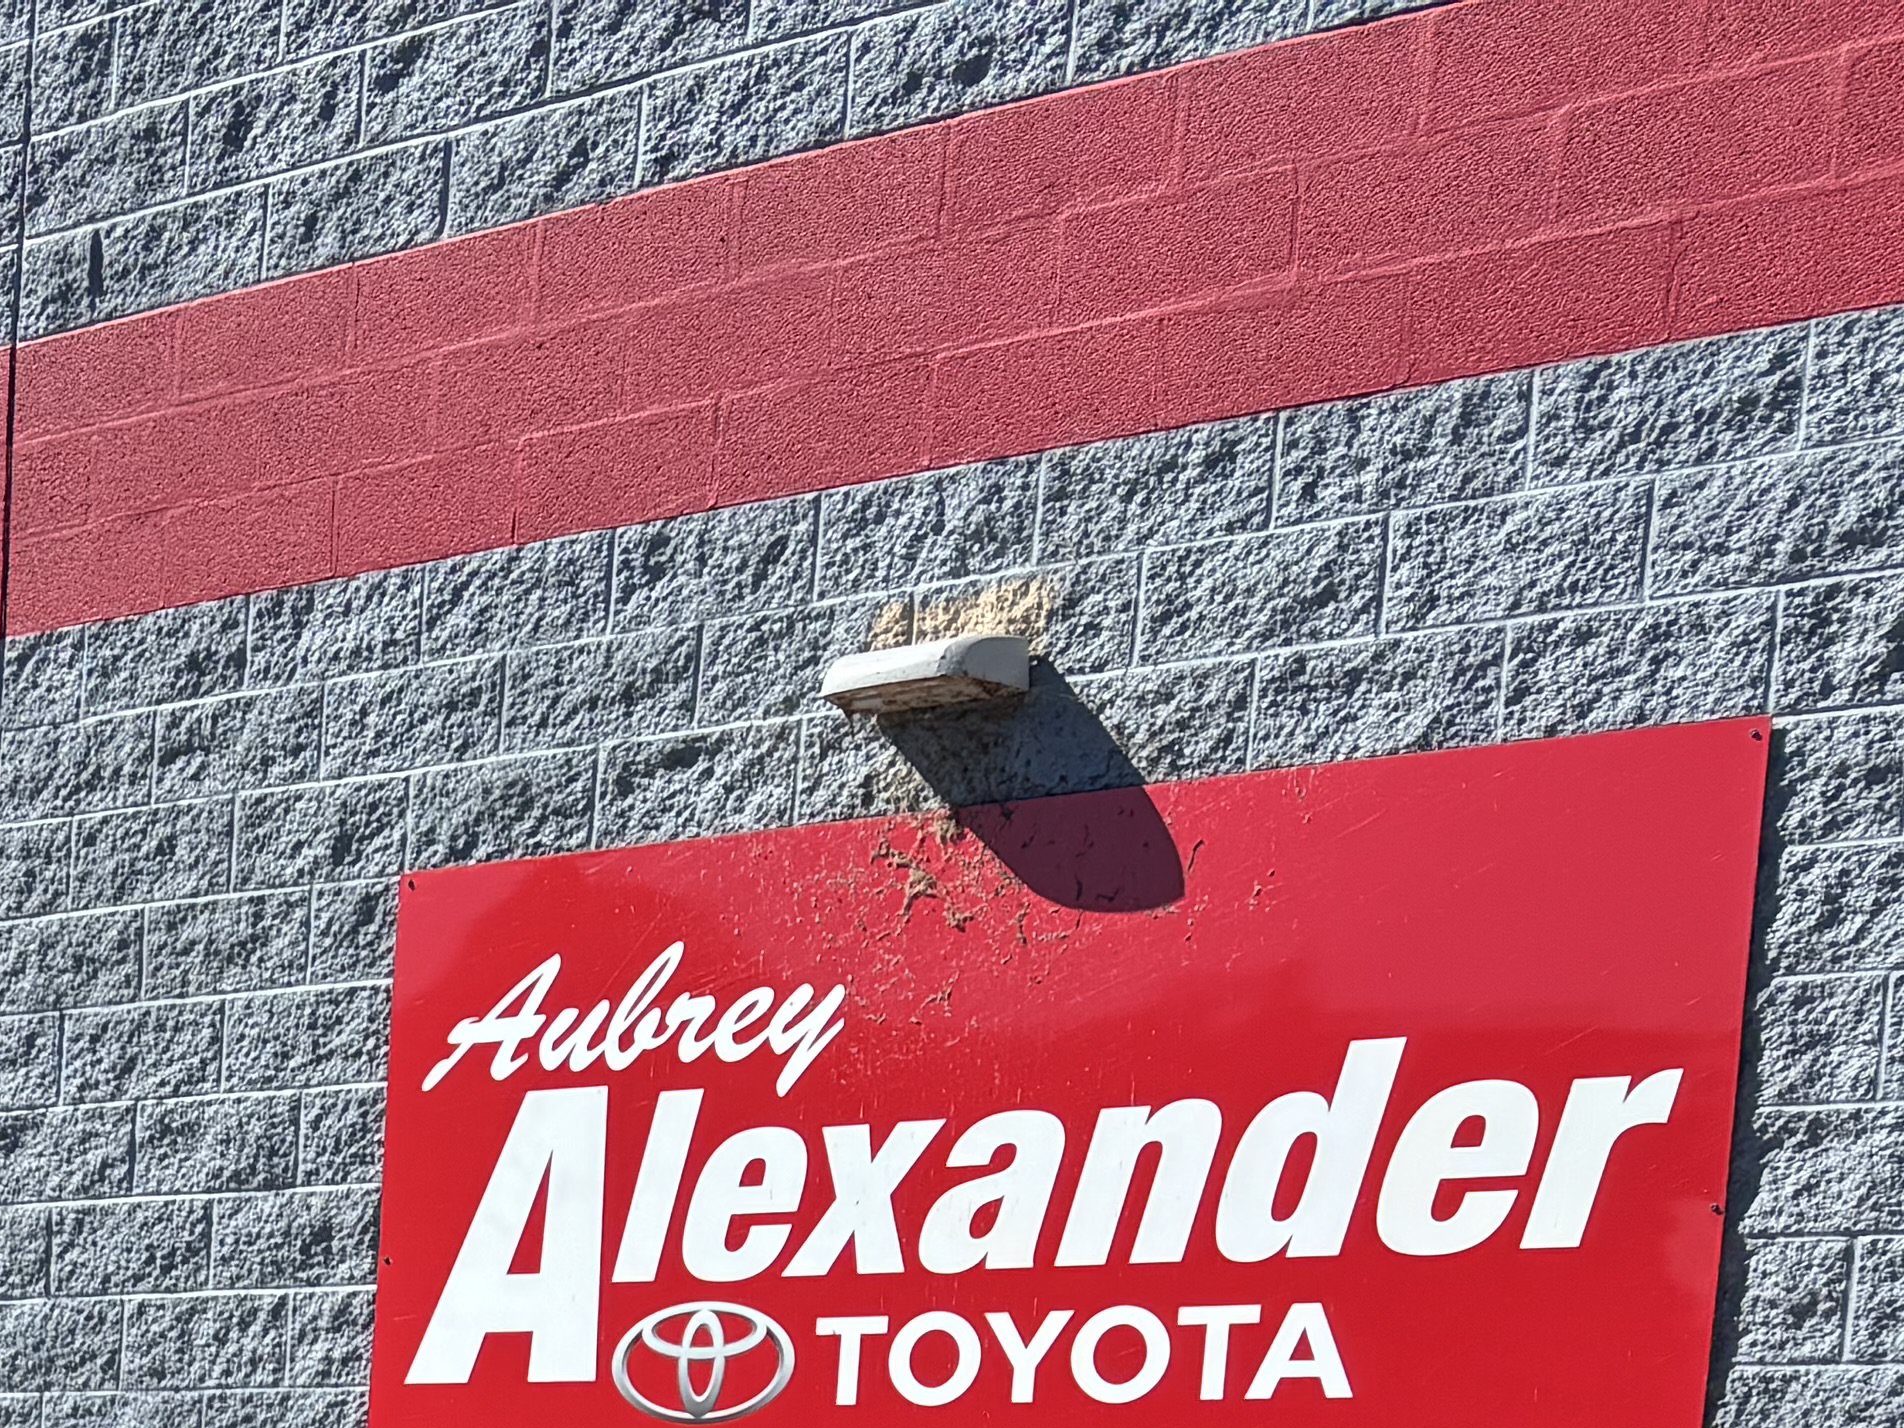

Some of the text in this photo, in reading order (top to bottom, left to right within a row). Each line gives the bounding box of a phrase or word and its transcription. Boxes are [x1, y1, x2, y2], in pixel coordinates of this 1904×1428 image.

[421, 940, 846, 1098] Aubrey
[403, 1036, 1684, 1385] Alexander
[815, 1302, 1354, 1407] TOYOTA
